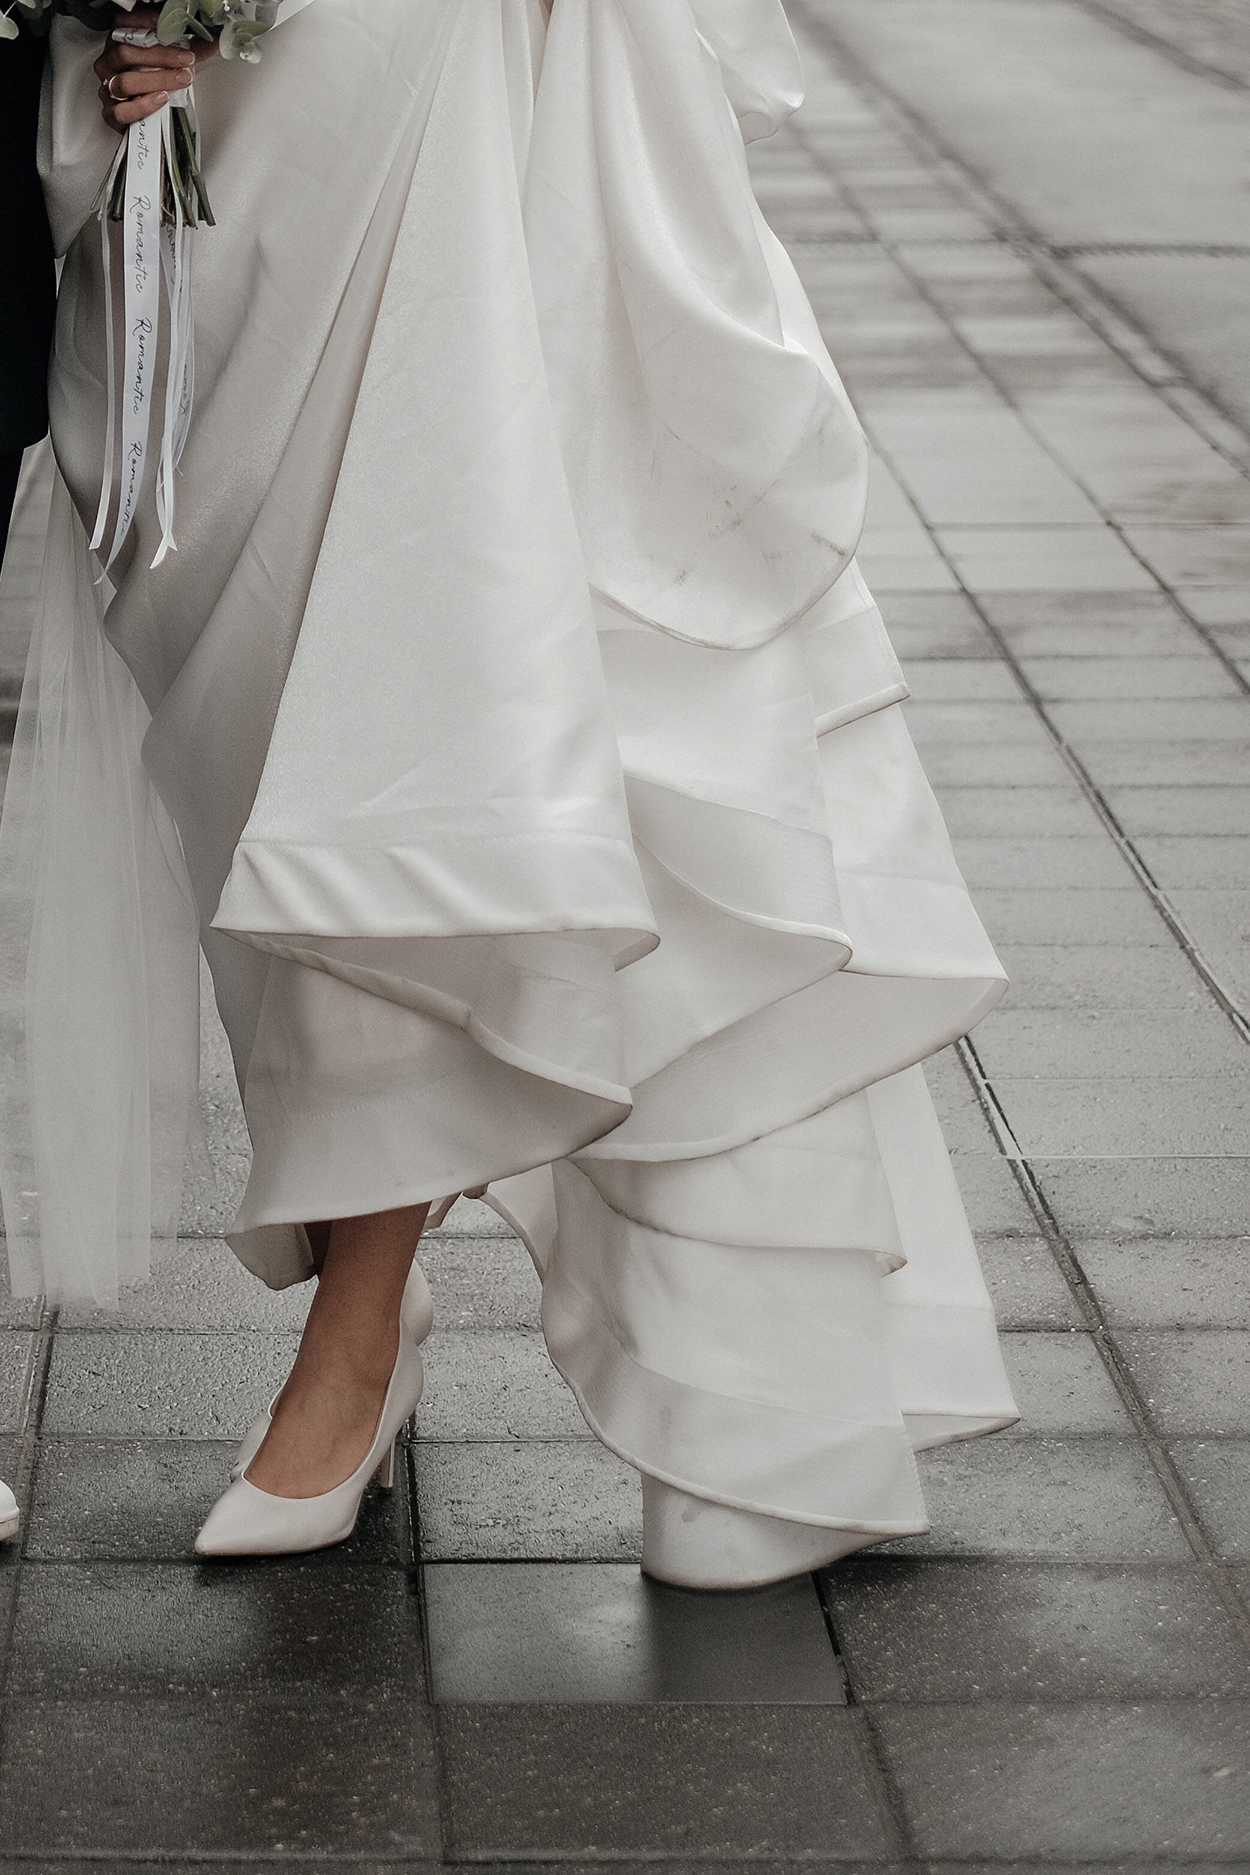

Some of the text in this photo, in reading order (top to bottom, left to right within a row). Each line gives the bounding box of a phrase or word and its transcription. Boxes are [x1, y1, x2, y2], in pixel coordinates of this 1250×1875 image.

[136, 119, 150, 170] antic
[129, 195, 151, 293] Romantic
[132, 317, 153, 415] Romantic
[121, 440, 143, 536] Romantic
